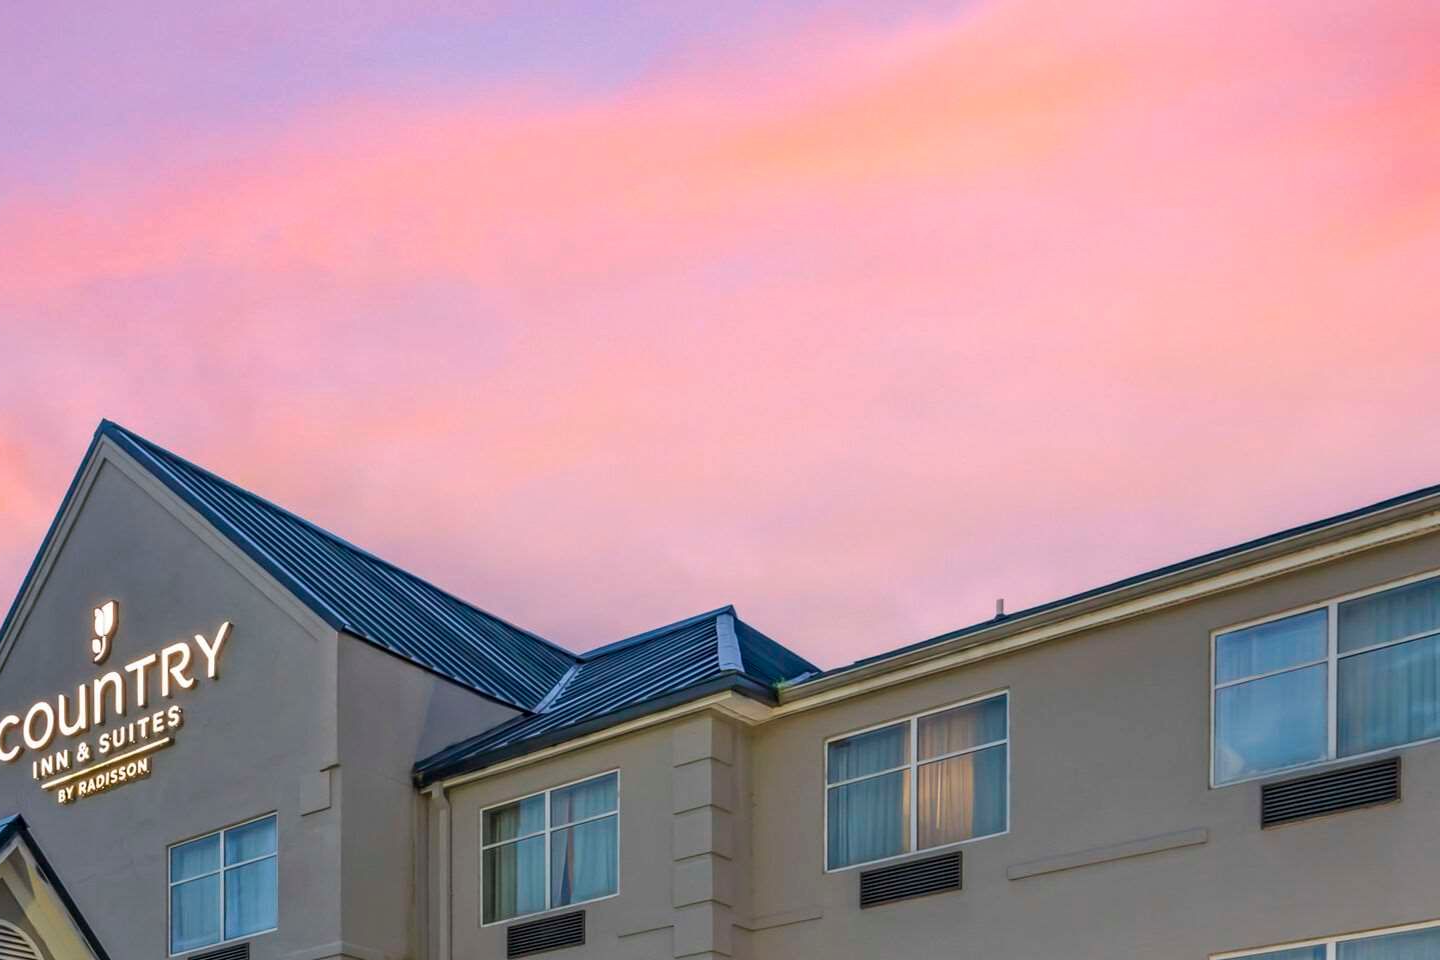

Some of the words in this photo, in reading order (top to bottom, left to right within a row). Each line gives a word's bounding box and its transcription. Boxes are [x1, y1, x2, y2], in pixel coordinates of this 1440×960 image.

[32, 749, 70, 779] INN
[76, 741, 91, 763] &
[98, 705, 183, 754] SUITES
[58, 785, 74, 803] BY
[78, 758, 149, 796] RADISSON
